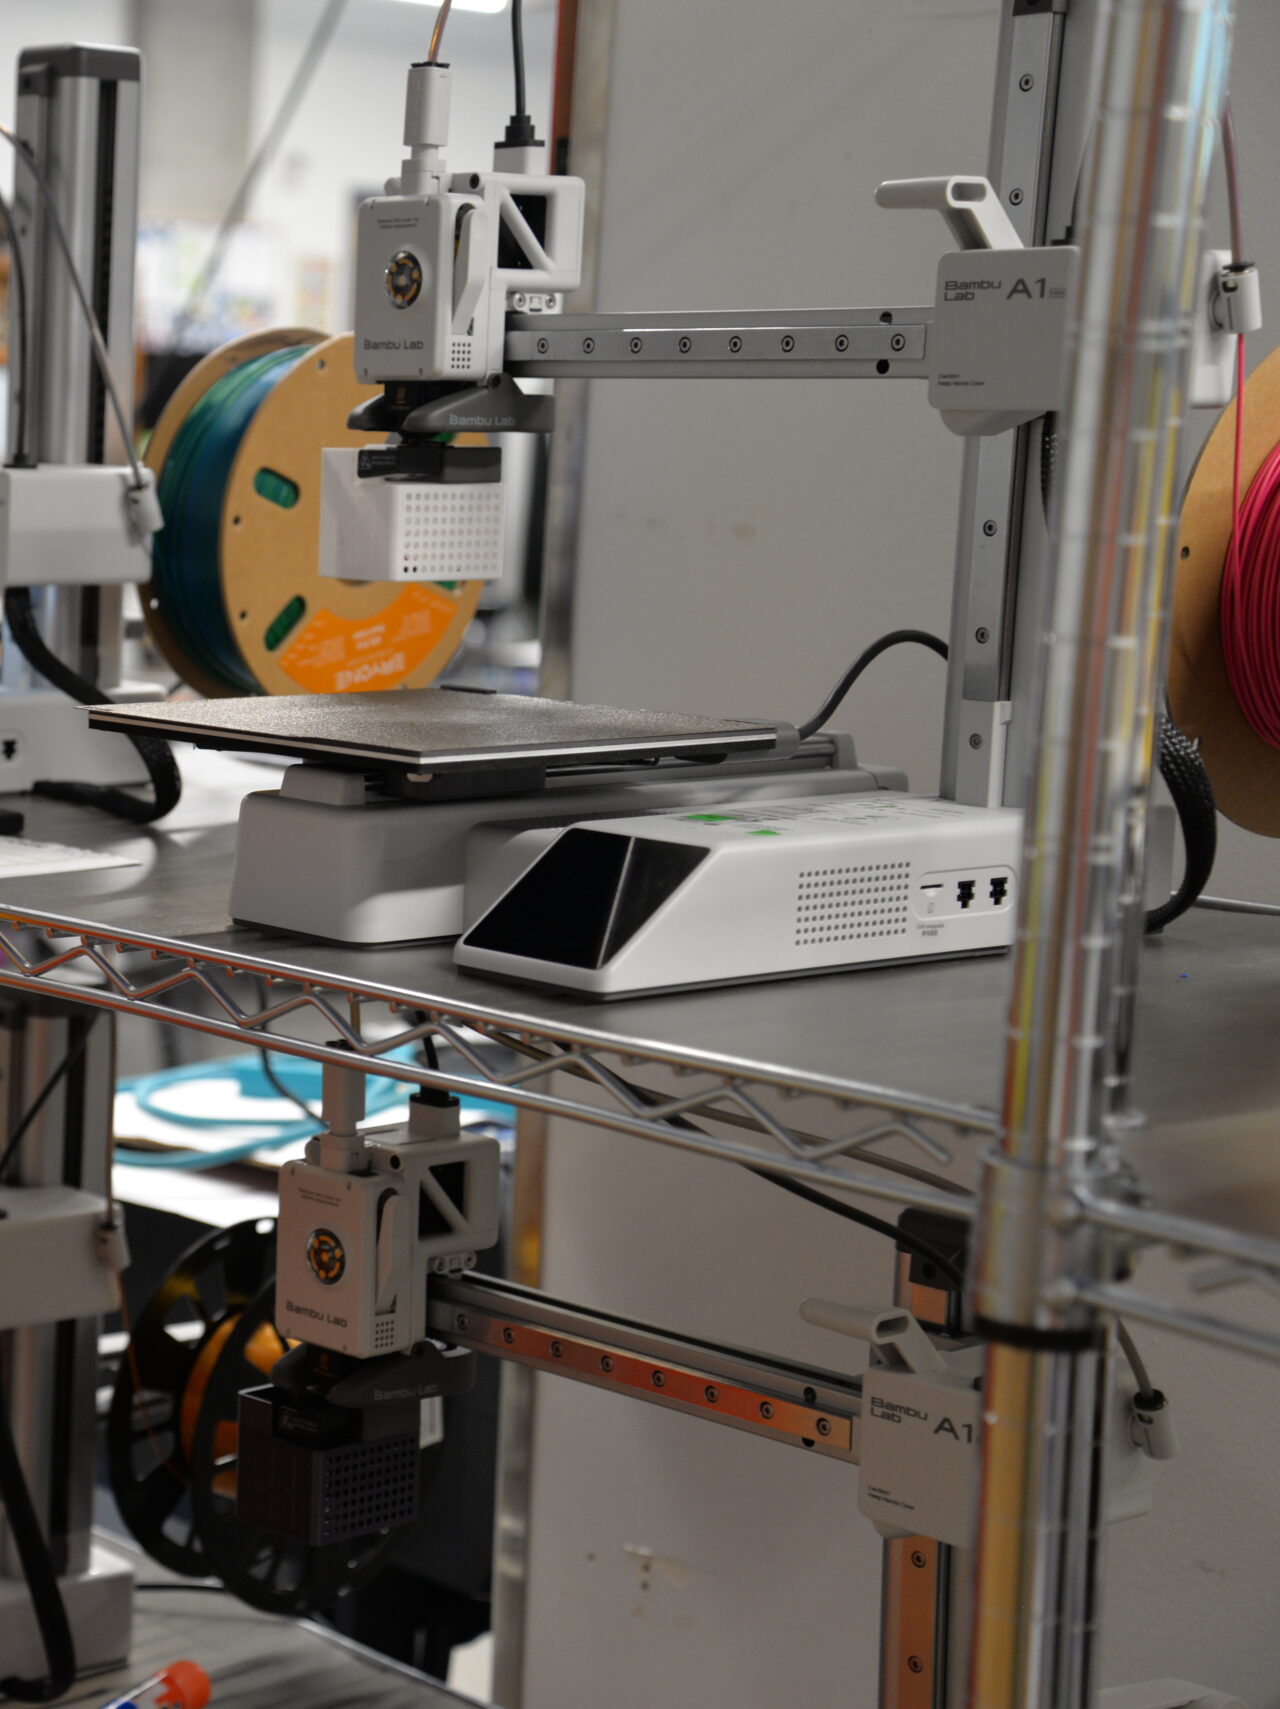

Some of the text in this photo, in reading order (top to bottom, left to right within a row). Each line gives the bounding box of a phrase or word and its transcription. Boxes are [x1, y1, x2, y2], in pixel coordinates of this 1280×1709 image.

[945, 280, 1001, 290] Bambu
[1006, 278, 1045, 299] A1
[944, 291, 975, 301] Lab
[363, 338, 424, 350] Bambu Lab
[449, 413, 516, 426] Bambu Lab
[286, 1299, 348, 1328] Bambu Lab
[374, 1387, 417, 1401] Bambu
[871, 1396, 928, 1421] Bambu
[871, 1406, 902, 1424] Lab
[933, 1417, 973, 1444] A1
